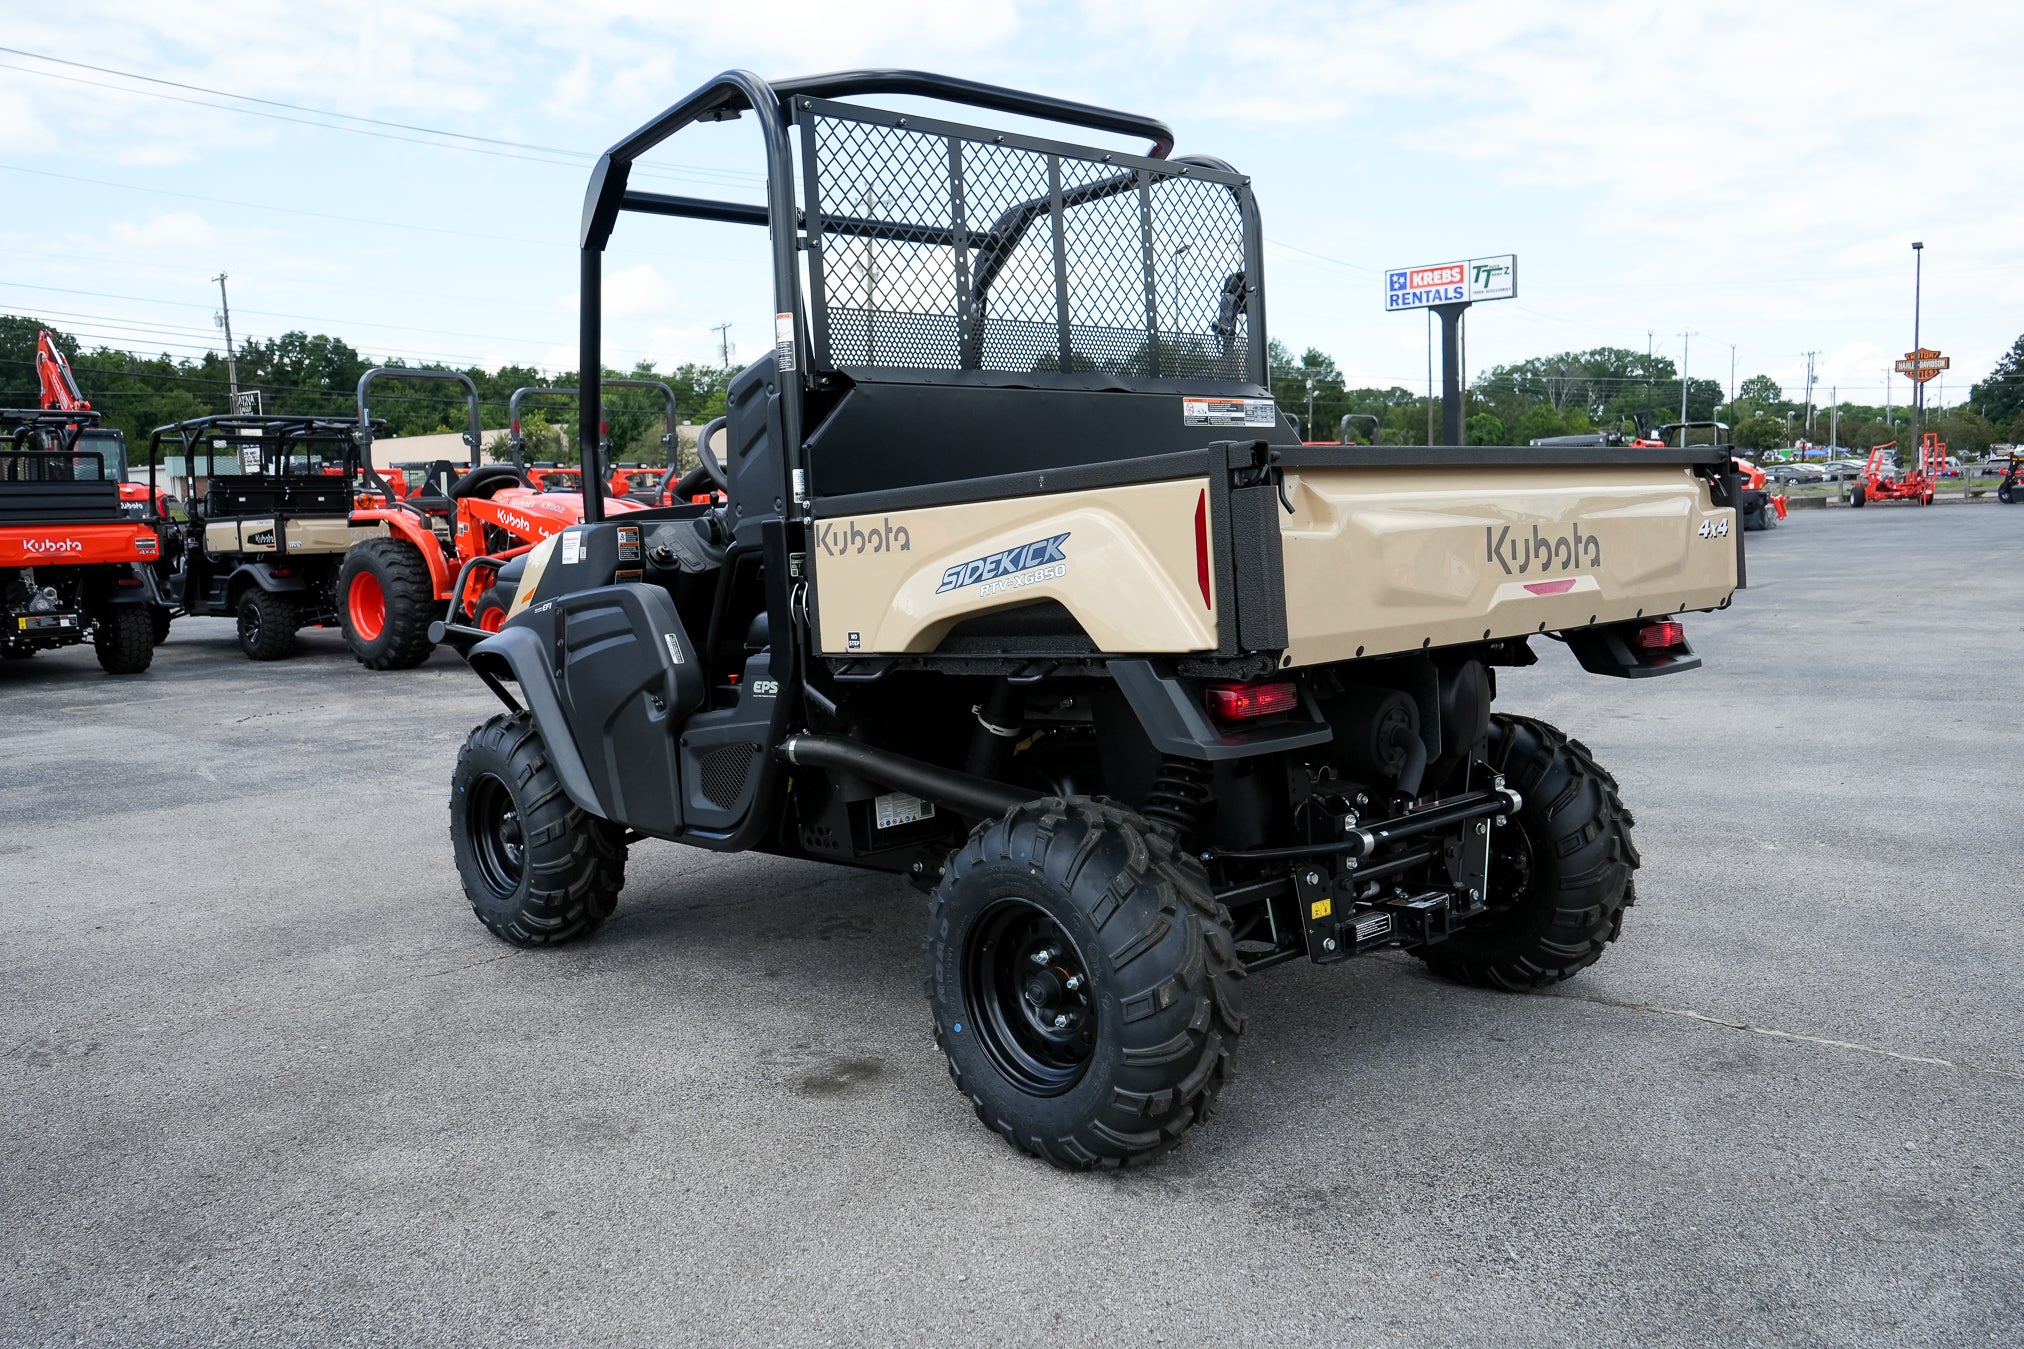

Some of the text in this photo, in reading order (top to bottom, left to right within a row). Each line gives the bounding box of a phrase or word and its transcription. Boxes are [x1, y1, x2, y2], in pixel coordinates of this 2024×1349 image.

[1412, 267, 1462, 287] KREBS
[1390, 286, 1464, 307] RENTALS
[497, 508, 530, 532] Kubota
[1698, 517, 1729, 539] 4x4
[23, 538, 82, 553] Kubota
[816, 517, 911, 557] Kubota
[1486, 522, 1601, 575] Kubota
[935, 531, 1071, 595] SIDEKICK
[979, 564, 1067, 597] RTV-XG850
[753, 681, 779, 694] EPS
